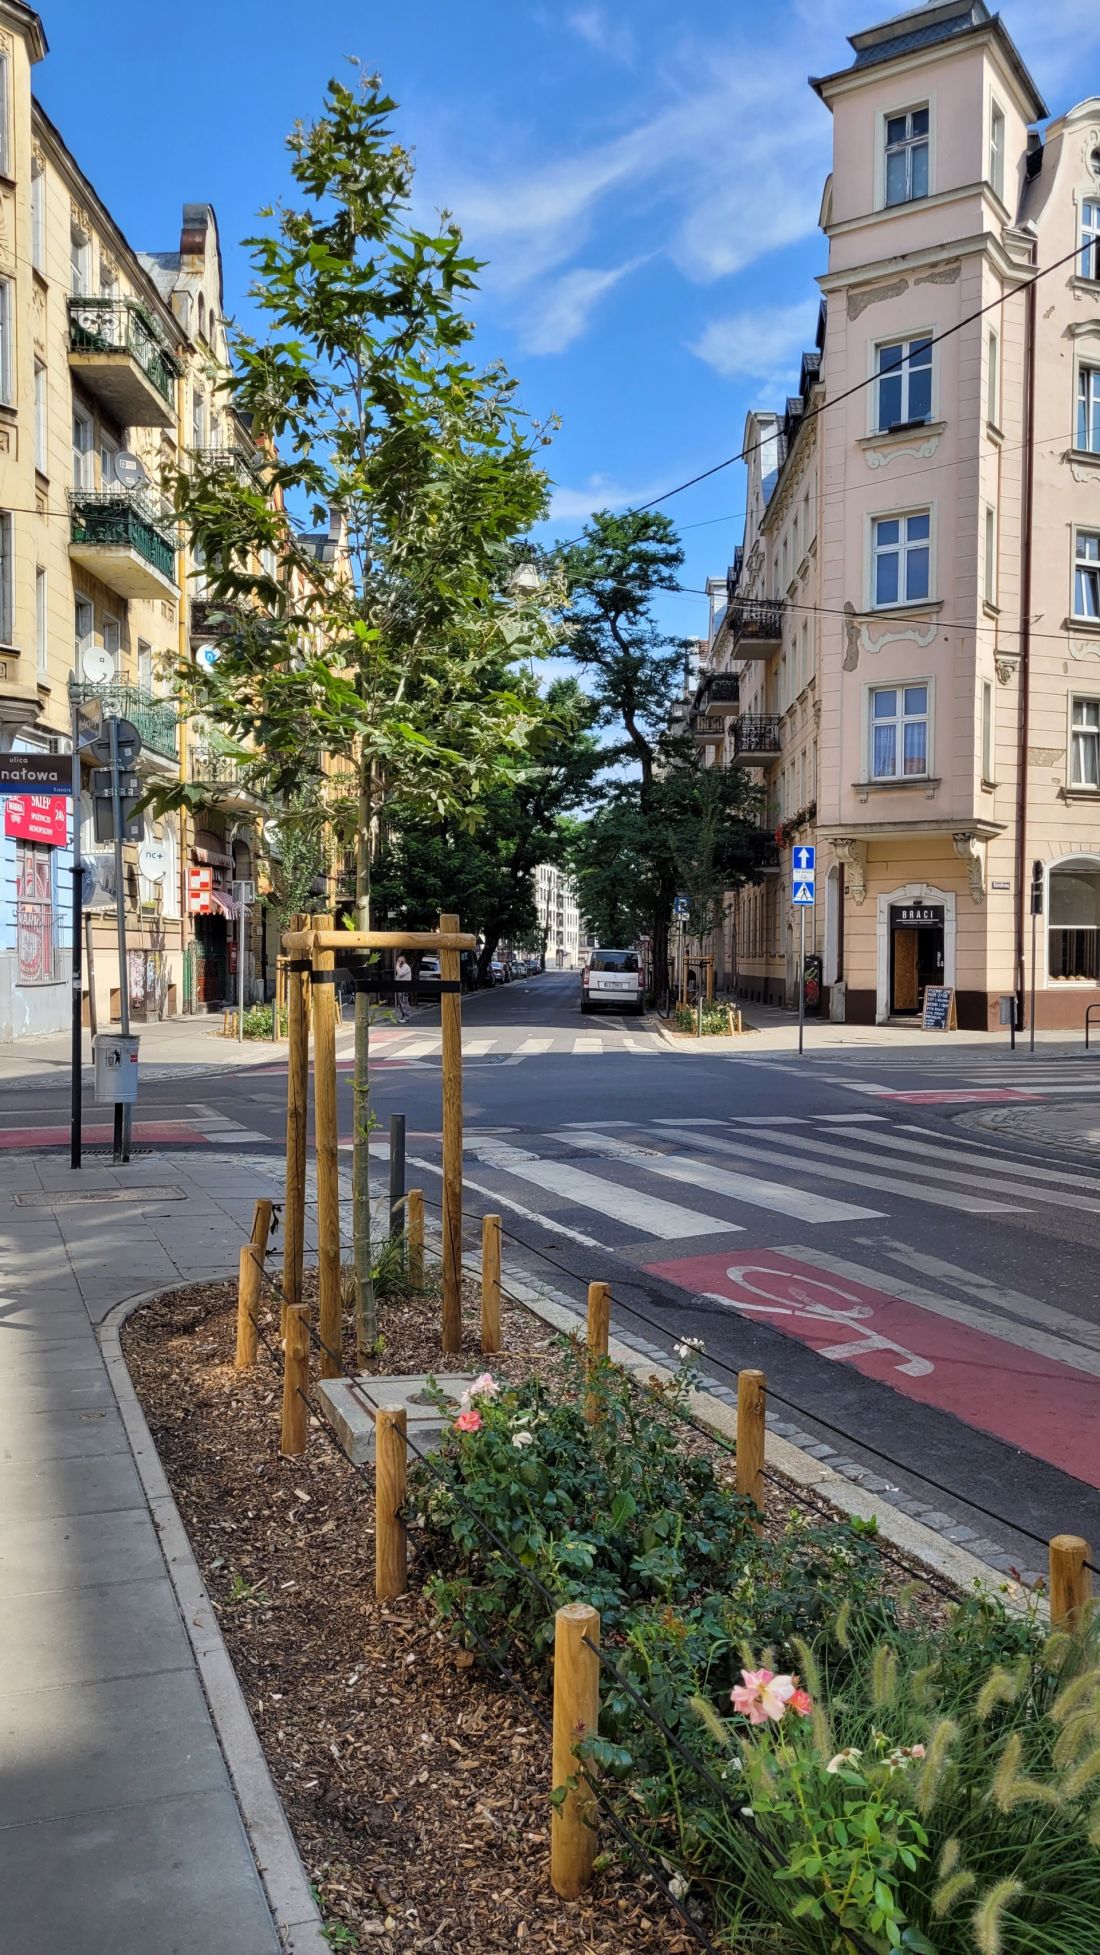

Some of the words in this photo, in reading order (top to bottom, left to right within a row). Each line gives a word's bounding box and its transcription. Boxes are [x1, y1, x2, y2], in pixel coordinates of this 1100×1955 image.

[9, 756, 28, 764] ulica
[31, 795, 51, 810] SKLEP
[902, 910, 933, 919] BRACI
